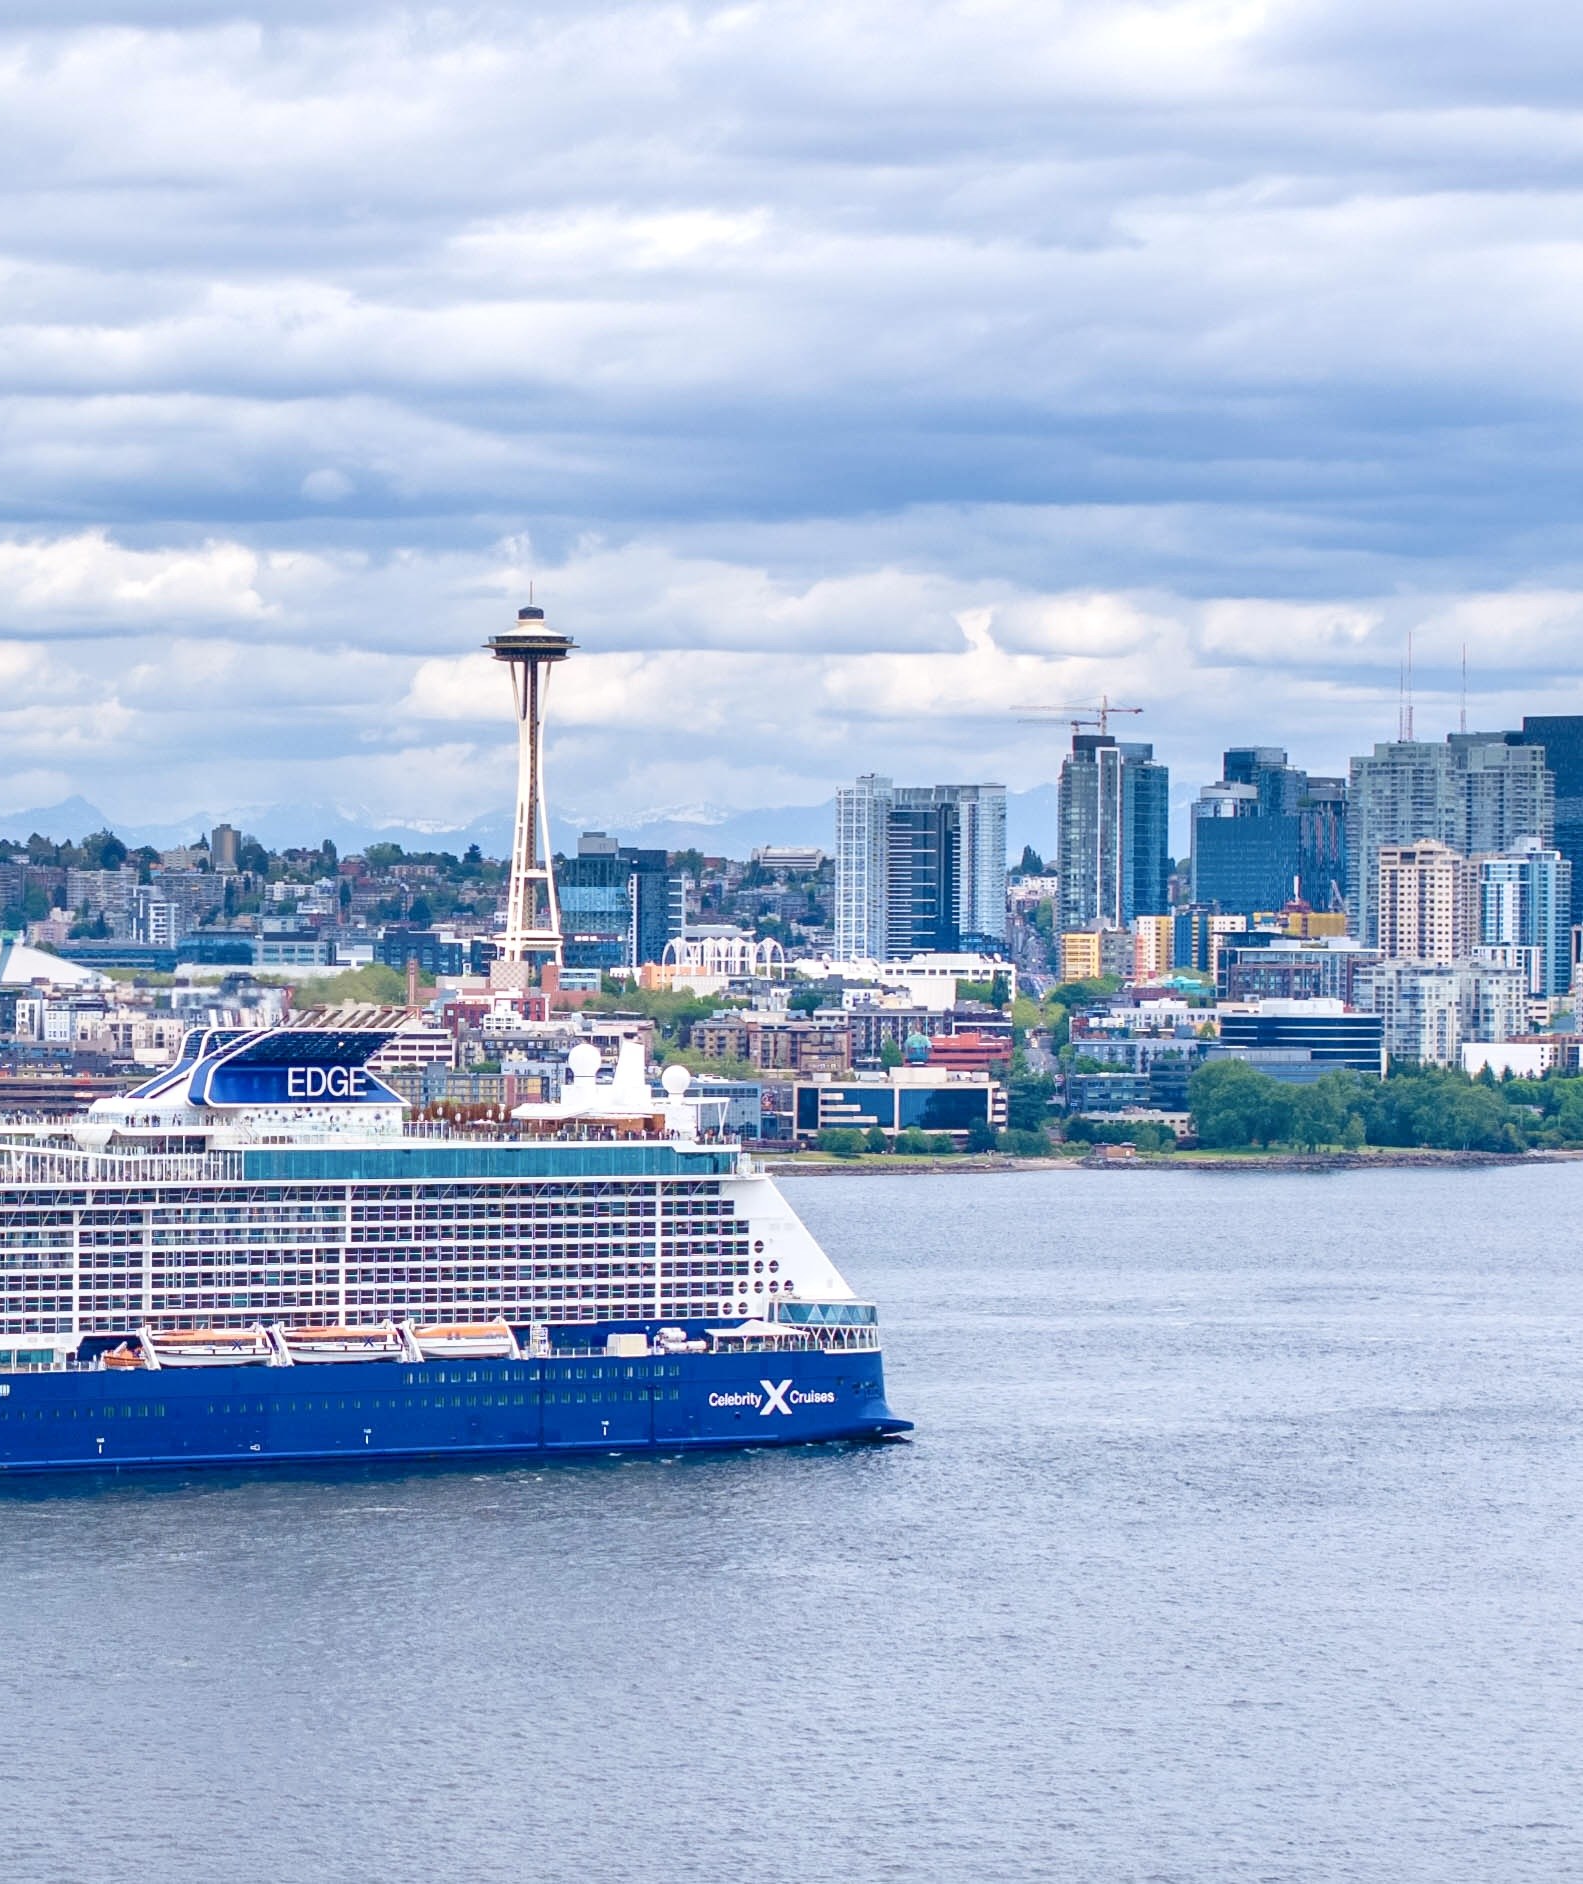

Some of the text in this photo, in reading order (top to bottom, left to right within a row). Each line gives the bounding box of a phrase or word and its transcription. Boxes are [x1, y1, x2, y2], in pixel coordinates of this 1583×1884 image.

[287, 1066, 367, 1096] EDGE
[708, 1379, 835, 1415] Celebrity X Cruises
